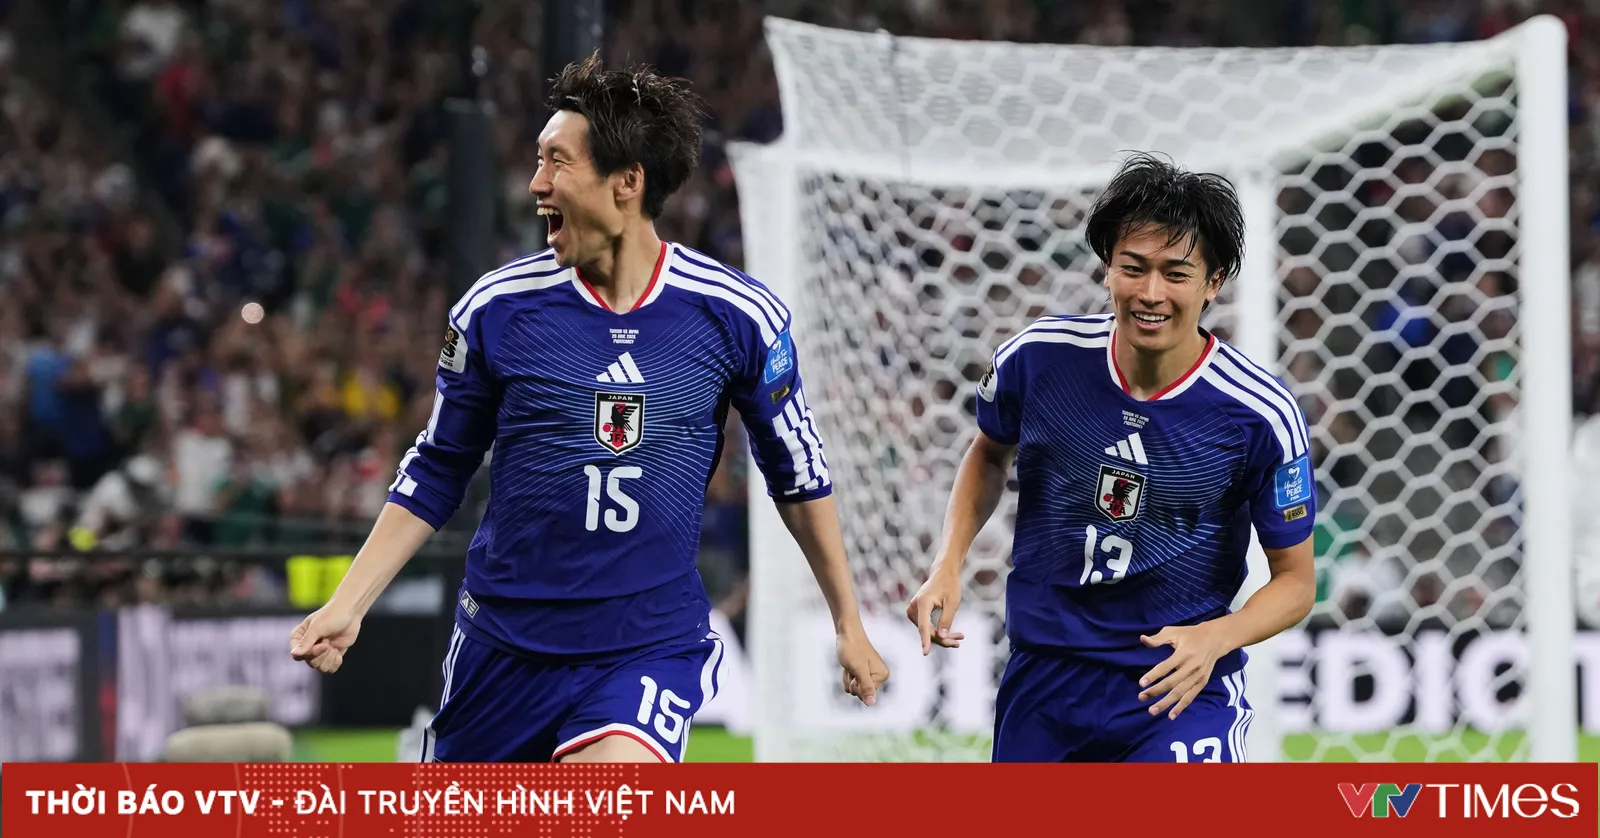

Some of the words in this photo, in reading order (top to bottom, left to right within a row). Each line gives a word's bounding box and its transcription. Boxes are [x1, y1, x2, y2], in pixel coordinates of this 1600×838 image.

[606, 432, 629, 444] JFA
[1112, 470, 1136, 479] JAPAN
[1286, 484, 1303, 497] PEACE
[583, 464, 643, 533] 15
[1079, 524, 1133, 586] 13
[636, 675, 691, 744] 15
